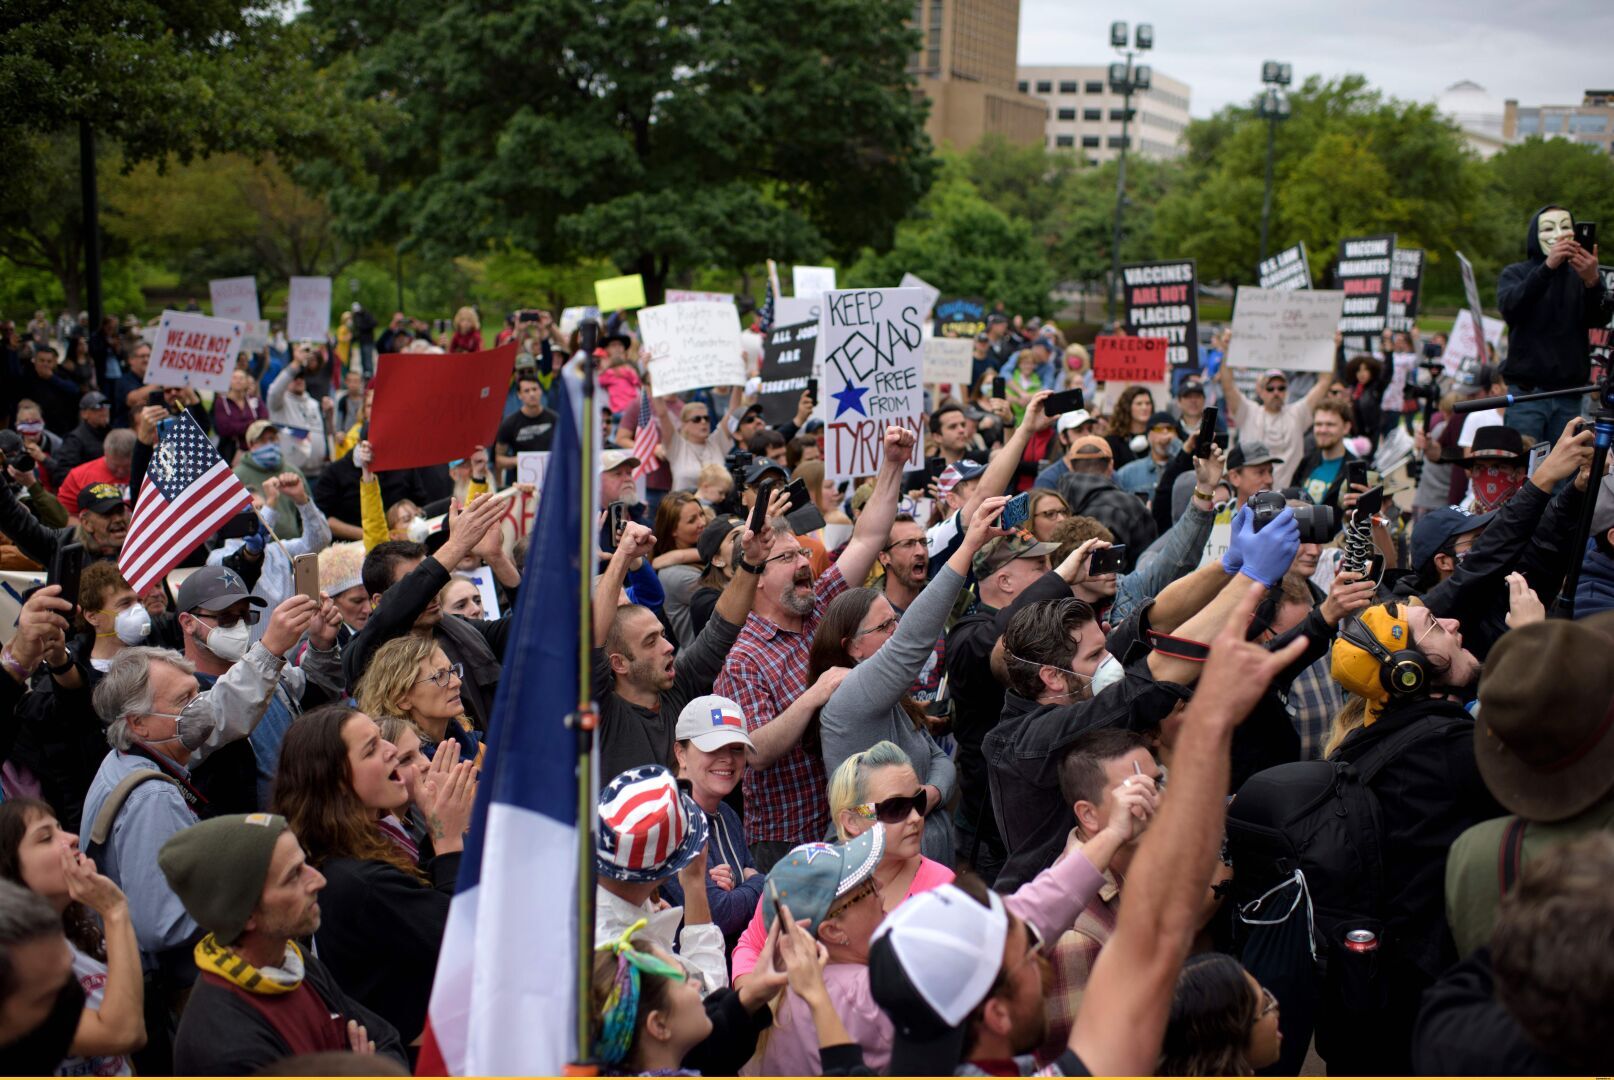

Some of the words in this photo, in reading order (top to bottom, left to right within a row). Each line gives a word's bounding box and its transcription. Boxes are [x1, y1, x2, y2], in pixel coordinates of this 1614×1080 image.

[1345, 239, 1388, 258] VACCINE
[1123, 264, 1192, 285] VACCINES
[1338, 258, 1391, 277] MANDATES
[1132, 287, 1158, 304] ARE
[1160, 285, 1188, 303] NOT
[829, 291, 883, 326] KEEP
[1343, 297, 1379, 313] BODILY
[1130, 305, 1192, 325] PLACEBO
[1337, 316, 1385, 332] UTONOMY
[167, 329, 184, 347] WE
[185, 332, 208, 350] ARE
[207, 335, 231, 354] NOT
[772, 329, 791, 345] ALL
[1137, 325, 1187, 343] SAFETY
[825, 306, 922, 391] TEXAS
[1101, 339, 1166, 351] FREEDOM
[160, 349, 225, 375] PRISONERS
[777, 349, 801, 364] ARE
[875, 367, 917, 394] FREE
[1094, 368, 1165, 381] ESSENTIAL
[869, 396, 910, 416] FROM
[828, 412, 924, 475] TYRAY
